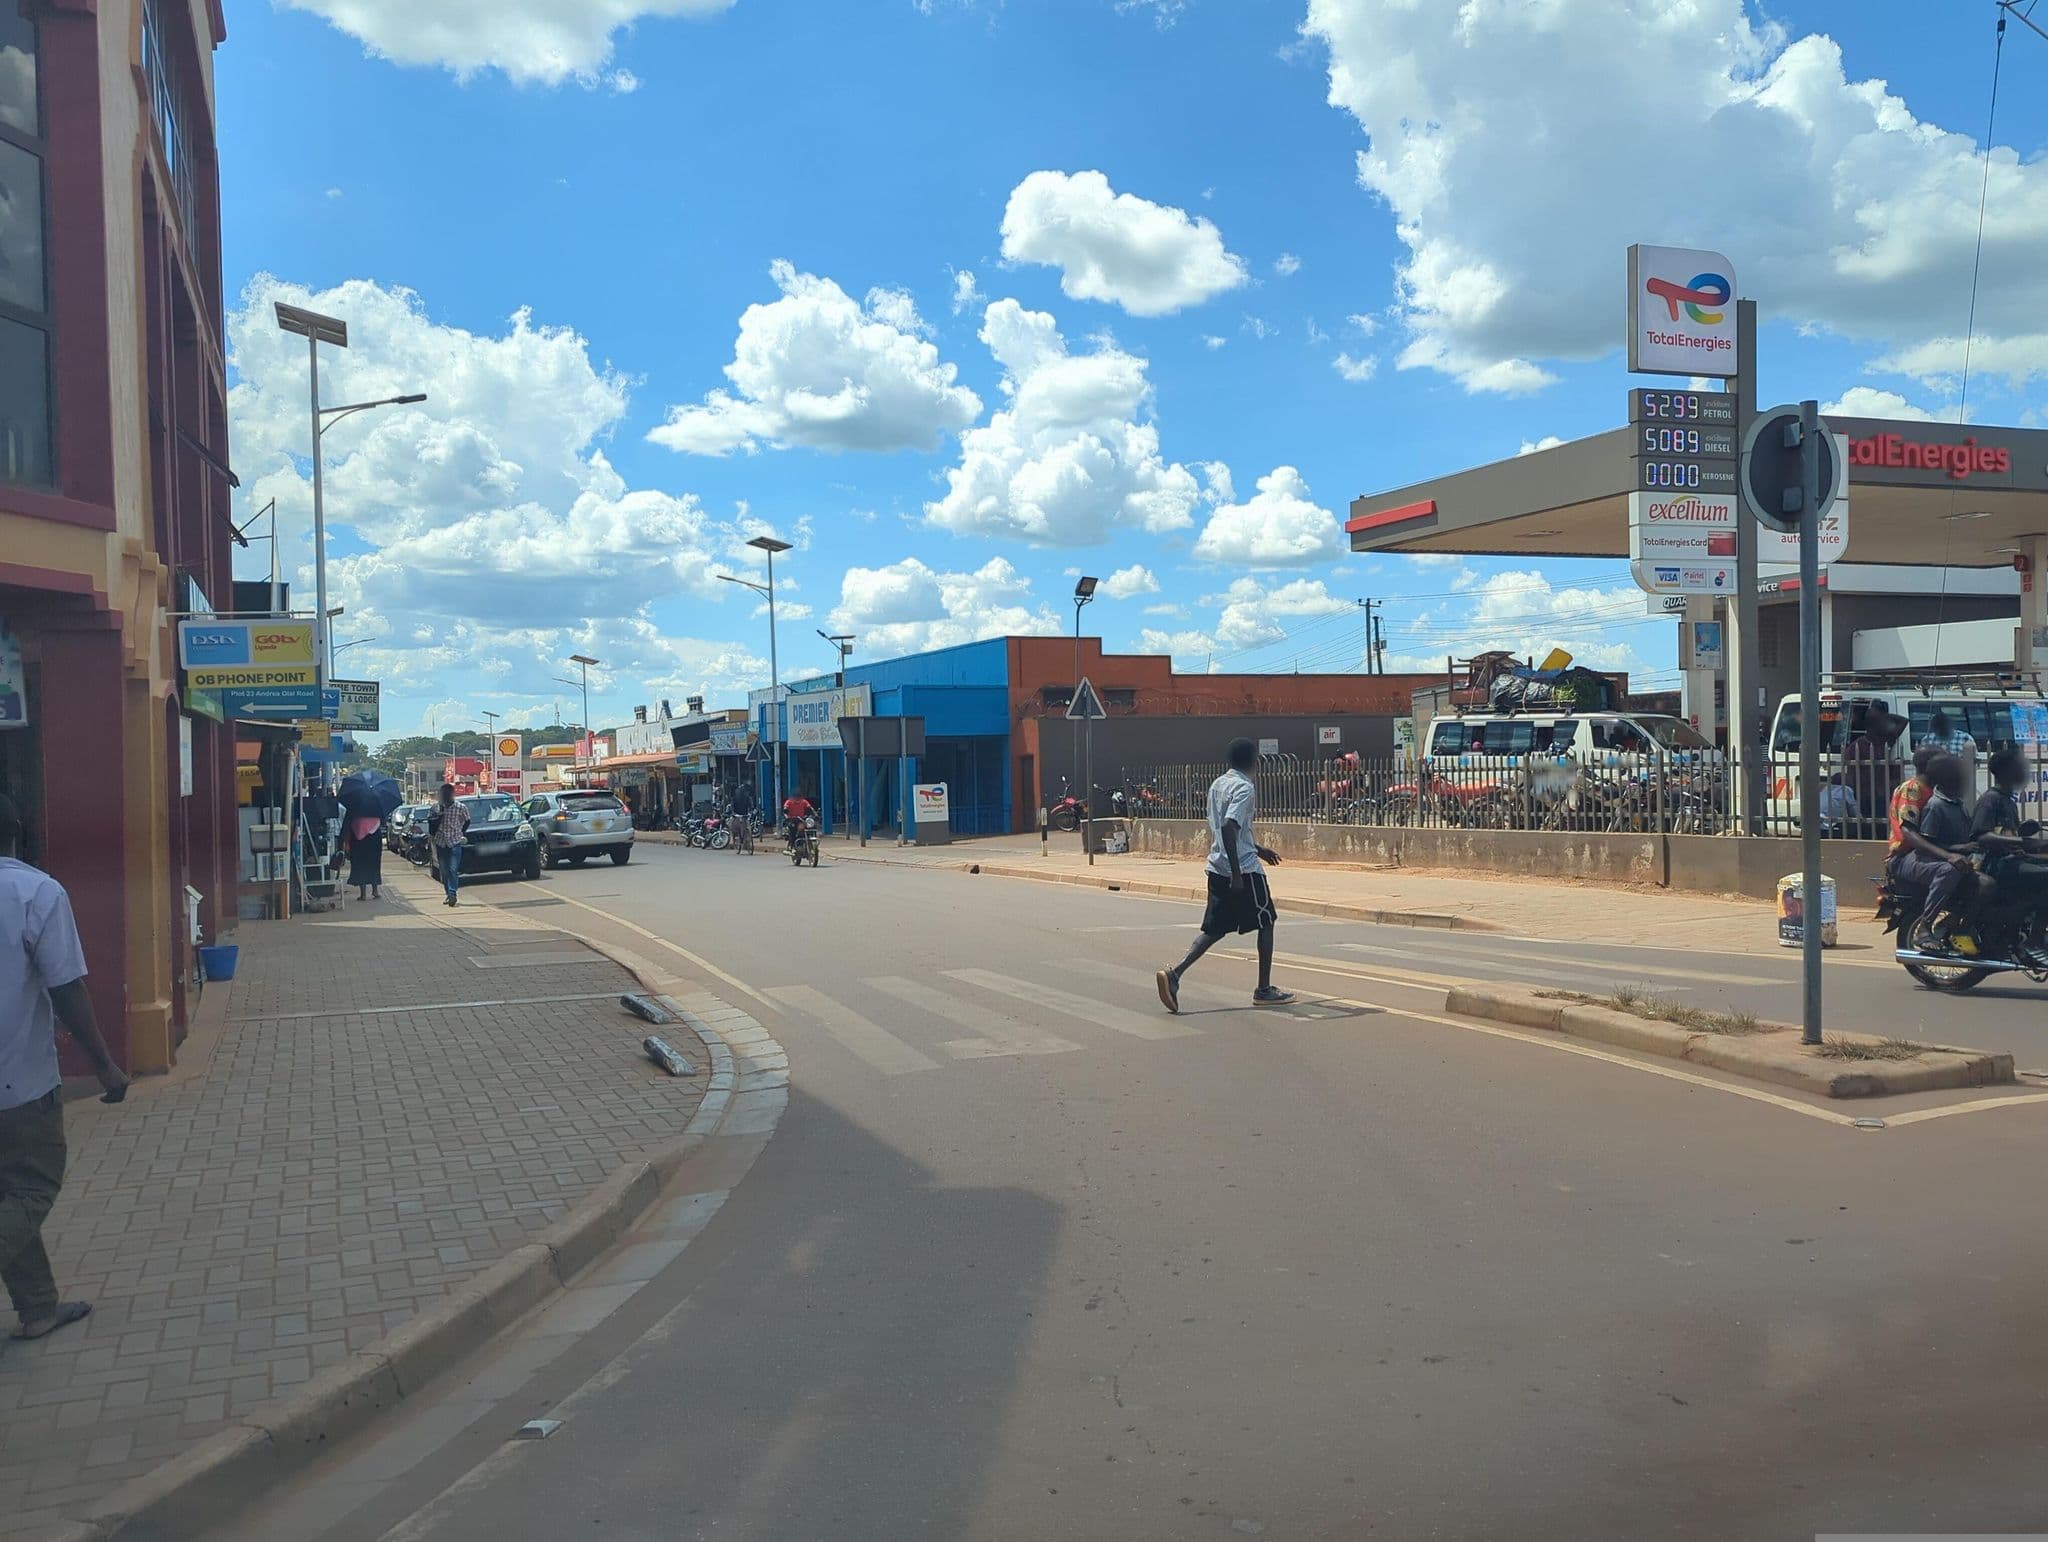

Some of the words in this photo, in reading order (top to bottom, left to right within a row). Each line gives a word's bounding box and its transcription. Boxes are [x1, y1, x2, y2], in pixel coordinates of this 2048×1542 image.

[1647, 331, 1732, 352] TotalEnergies
[1645, 394, 1699, 419] 5299
[1703, 409, 1733, 419] PETROL
[1645, 428, 1699, 453] 5089
[1704, 443, 1731, 453] DIESEL
[1645, 462, 1699, 487] 0000
[1649, 500, 1729, 523] excellium
[1644, 537, 1690, 548] TotalEnergies
[1691, 538, 1707, 547] Card
[1659, 573, 1678, 582] VISA
[195, 674, 216, 685] OB
[219, 673, 265, 684] PHONE
[266, 672, 306, 683] POINT
[352, 684, 375, 692] TOWN
[354, 696, 377, 704] LODGE
[793, 701, 830, 723] PREMIER
[1324, 728, 1336, 739] air
